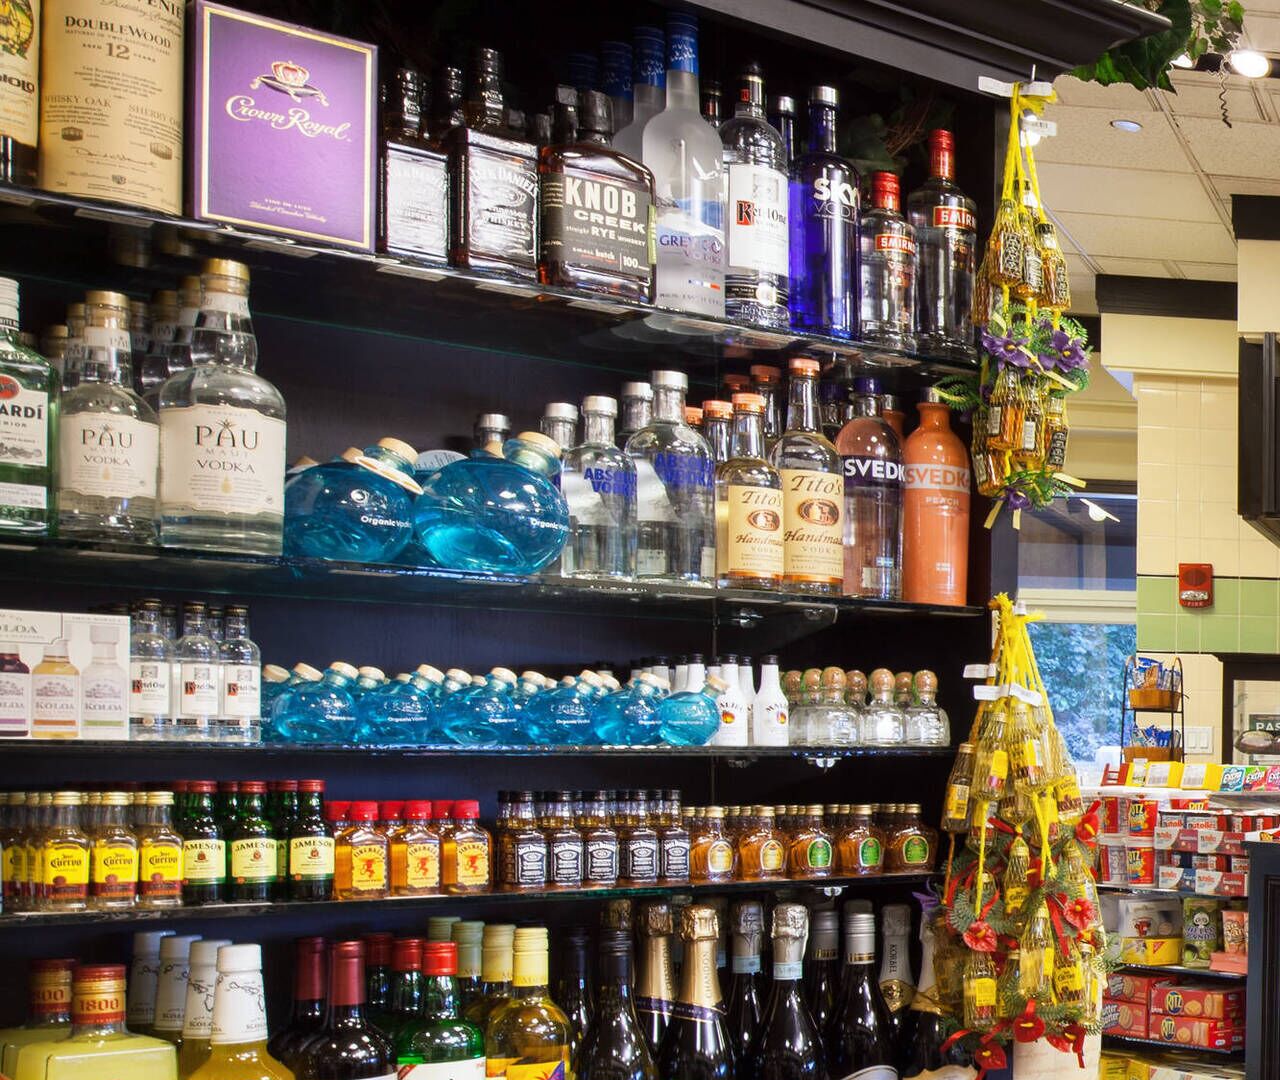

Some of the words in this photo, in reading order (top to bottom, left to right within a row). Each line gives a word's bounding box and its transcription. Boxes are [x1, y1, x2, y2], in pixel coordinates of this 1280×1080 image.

[64, 15, 172, 49] DOUBLEWOOD
[104, 42, 131, 60] 12
[225, 95, 284, 130] Crown
[282, 106, 349, 140] Royal
[564, 176, 637, 218] KNOB
[573, 208, 647, 234] CREEK
[591, 226, 617, 241] RYE
[83, 454, 131, 467] VODKA
[197, 459, 256, 474] VODKA
[845, 458, 906, 482] SVEDK
[360, 515, 396, 528] Organic
[235, 842, 276, 852] JAMESON
[294, 840, 334, 850] JAMESON
[79, 997, 119, 1012] 1800
